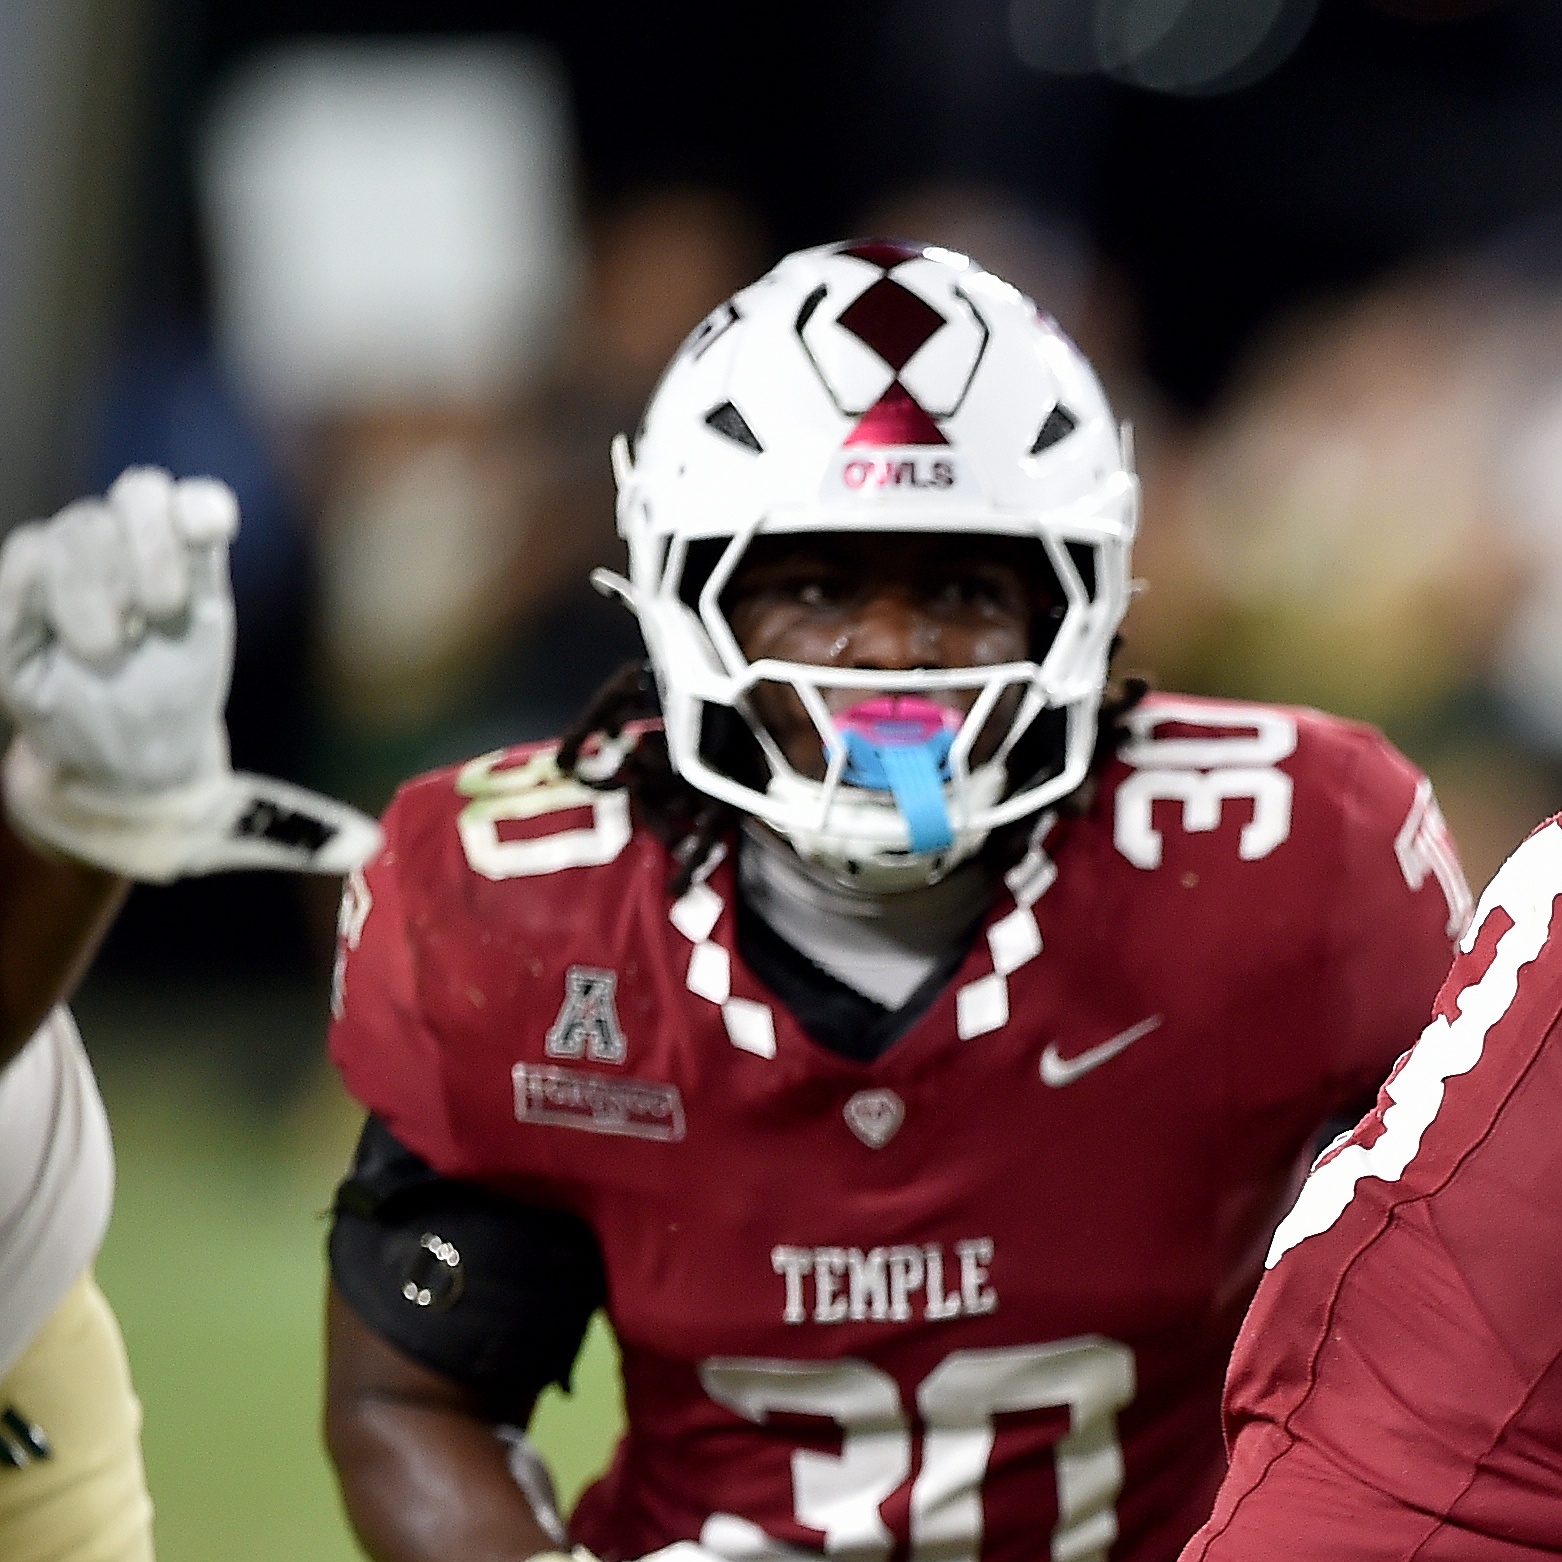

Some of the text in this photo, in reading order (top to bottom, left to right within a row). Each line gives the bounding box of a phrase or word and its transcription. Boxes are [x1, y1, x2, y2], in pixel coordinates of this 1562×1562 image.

[843, 459, 954, 491] OWLS
[1112, 705, 1300, 872] 30
[771, 1238, 998, 1325] TEMPLE
